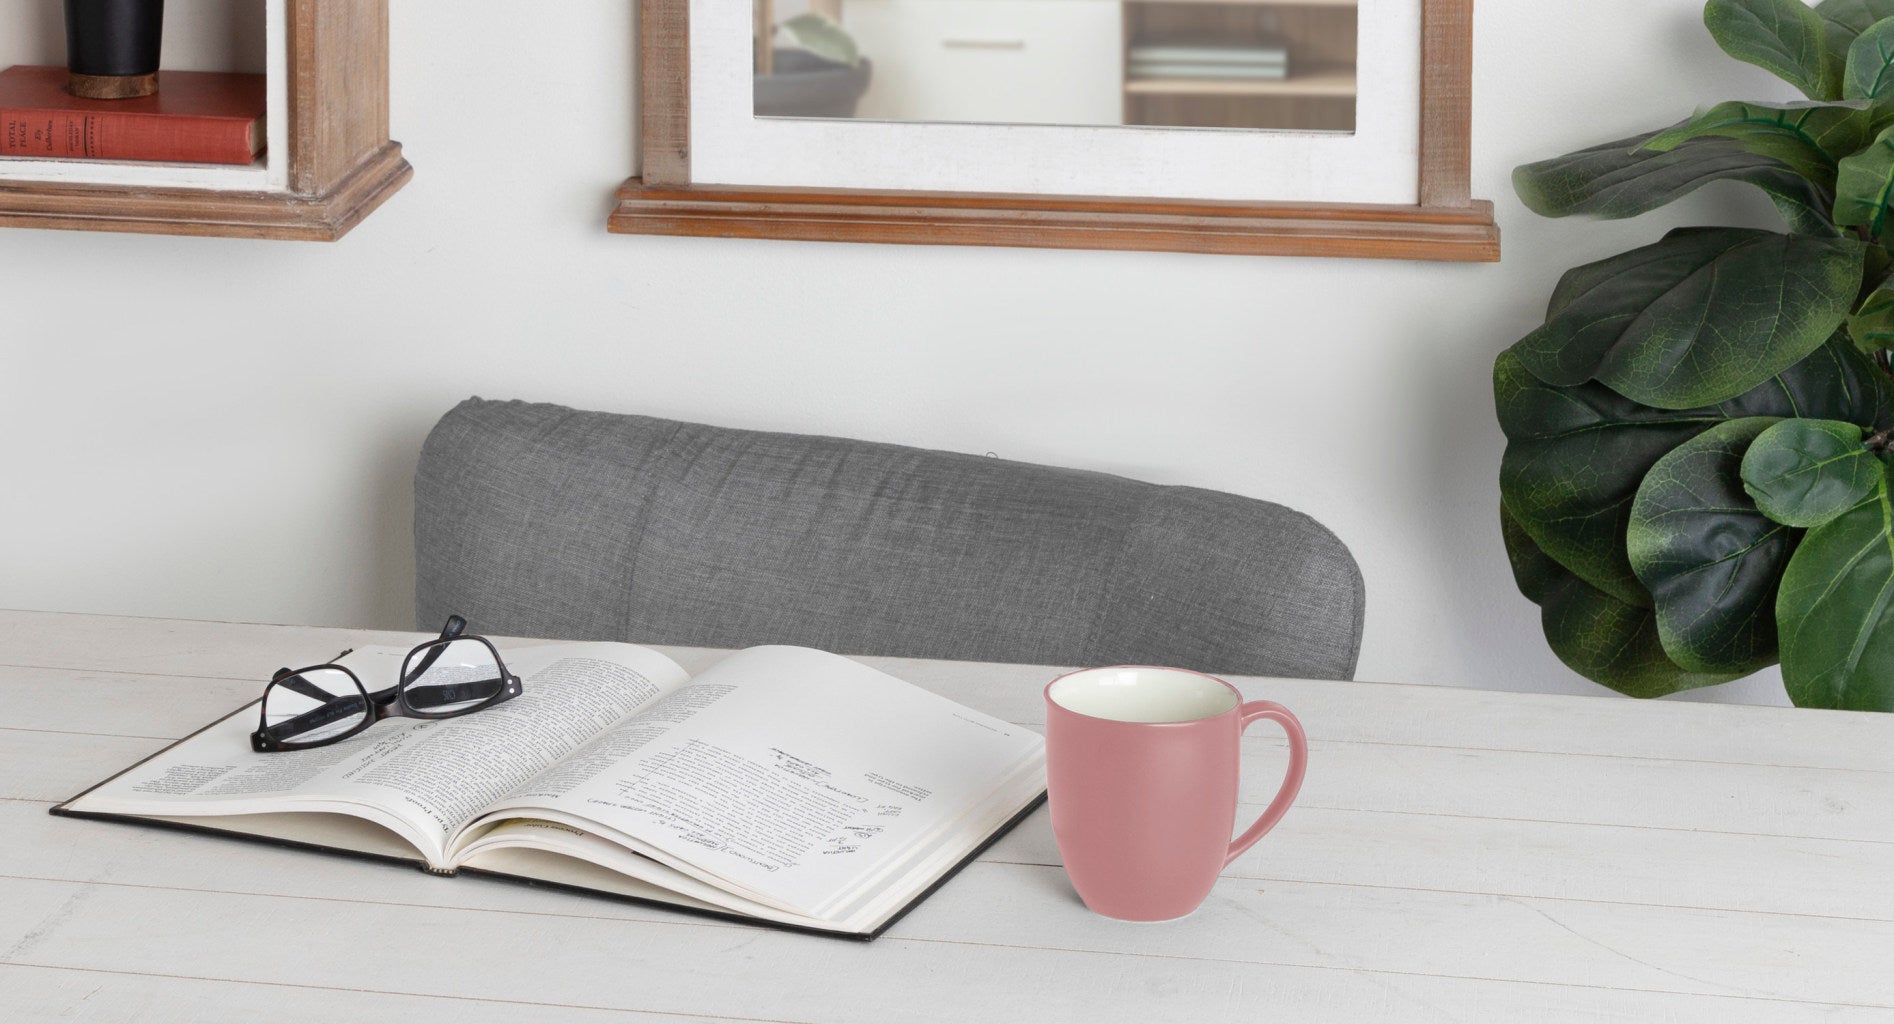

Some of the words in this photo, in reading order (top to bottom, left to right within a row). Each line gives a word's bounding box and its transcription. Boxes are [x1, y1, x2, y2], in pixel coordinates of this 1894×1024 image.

[9, 120, 17, 149] TOTAL
[404, 795, 432, 814] Proofs
[432, 813, 449, 833] Type
[549, 826, 584, 838] Process
